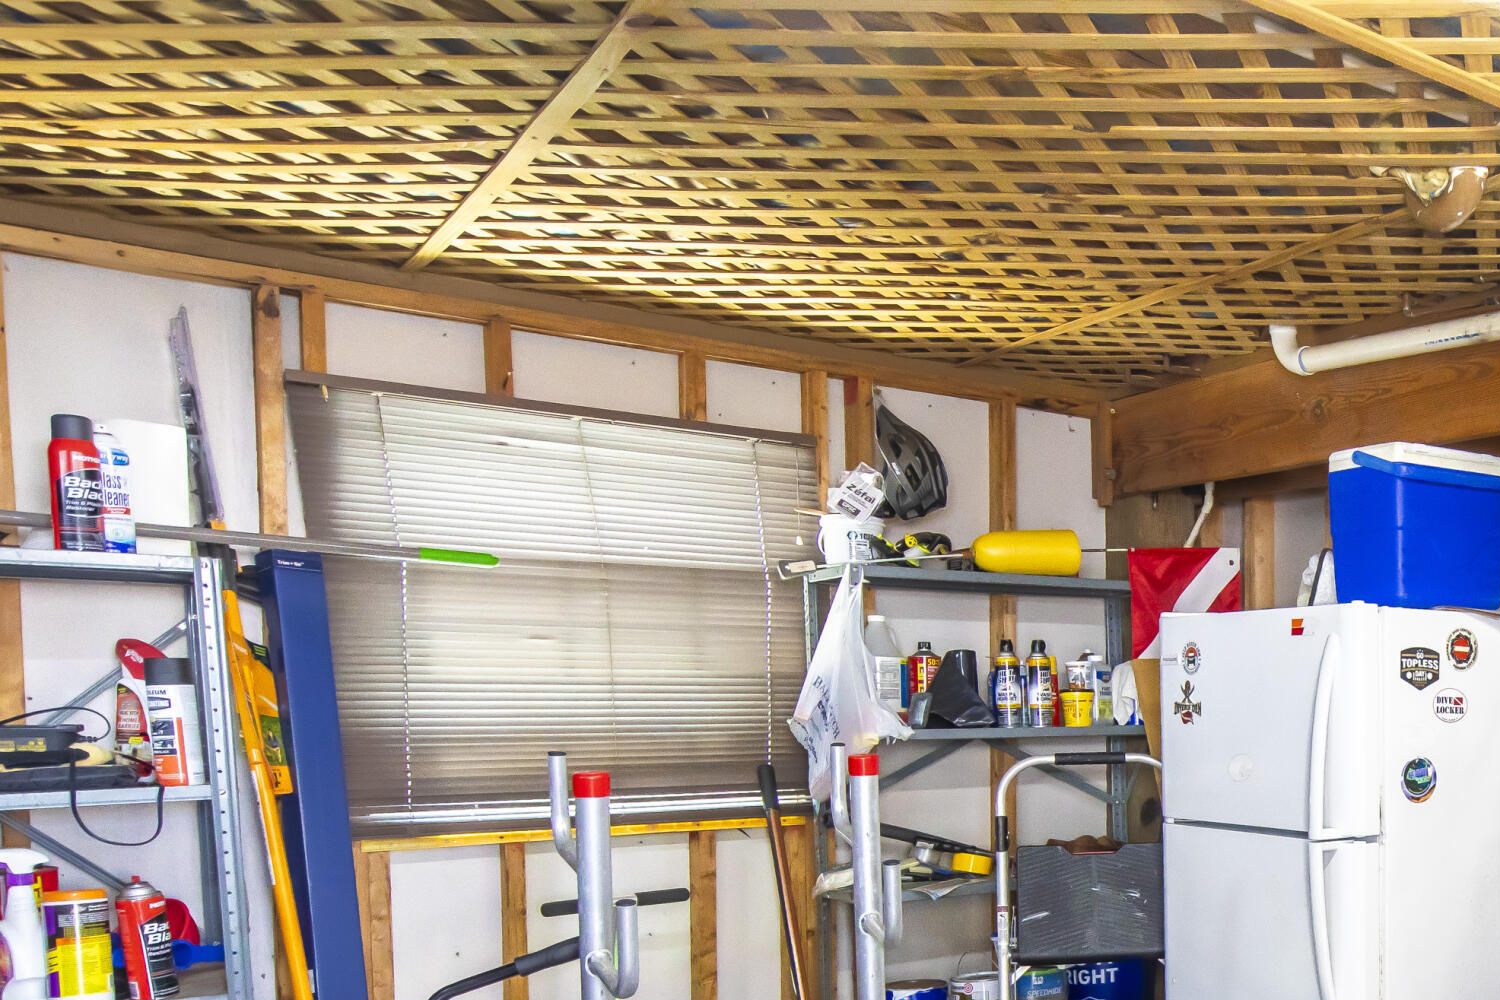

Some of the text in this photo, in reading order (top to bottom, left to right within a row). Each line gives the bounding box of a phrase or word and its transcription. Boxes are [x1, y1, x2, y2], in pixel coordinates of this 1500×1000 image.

[102, 471, 121, 489] lass
[103, 489, 130, 506] leaner
[846, 483, 876, 504] Zéfal
[1401, 658, 1439, 670] TOPLESS
[1436, 696, 1453, 704] DIVE
[1436, 706, 1464, 714] LOCKER
